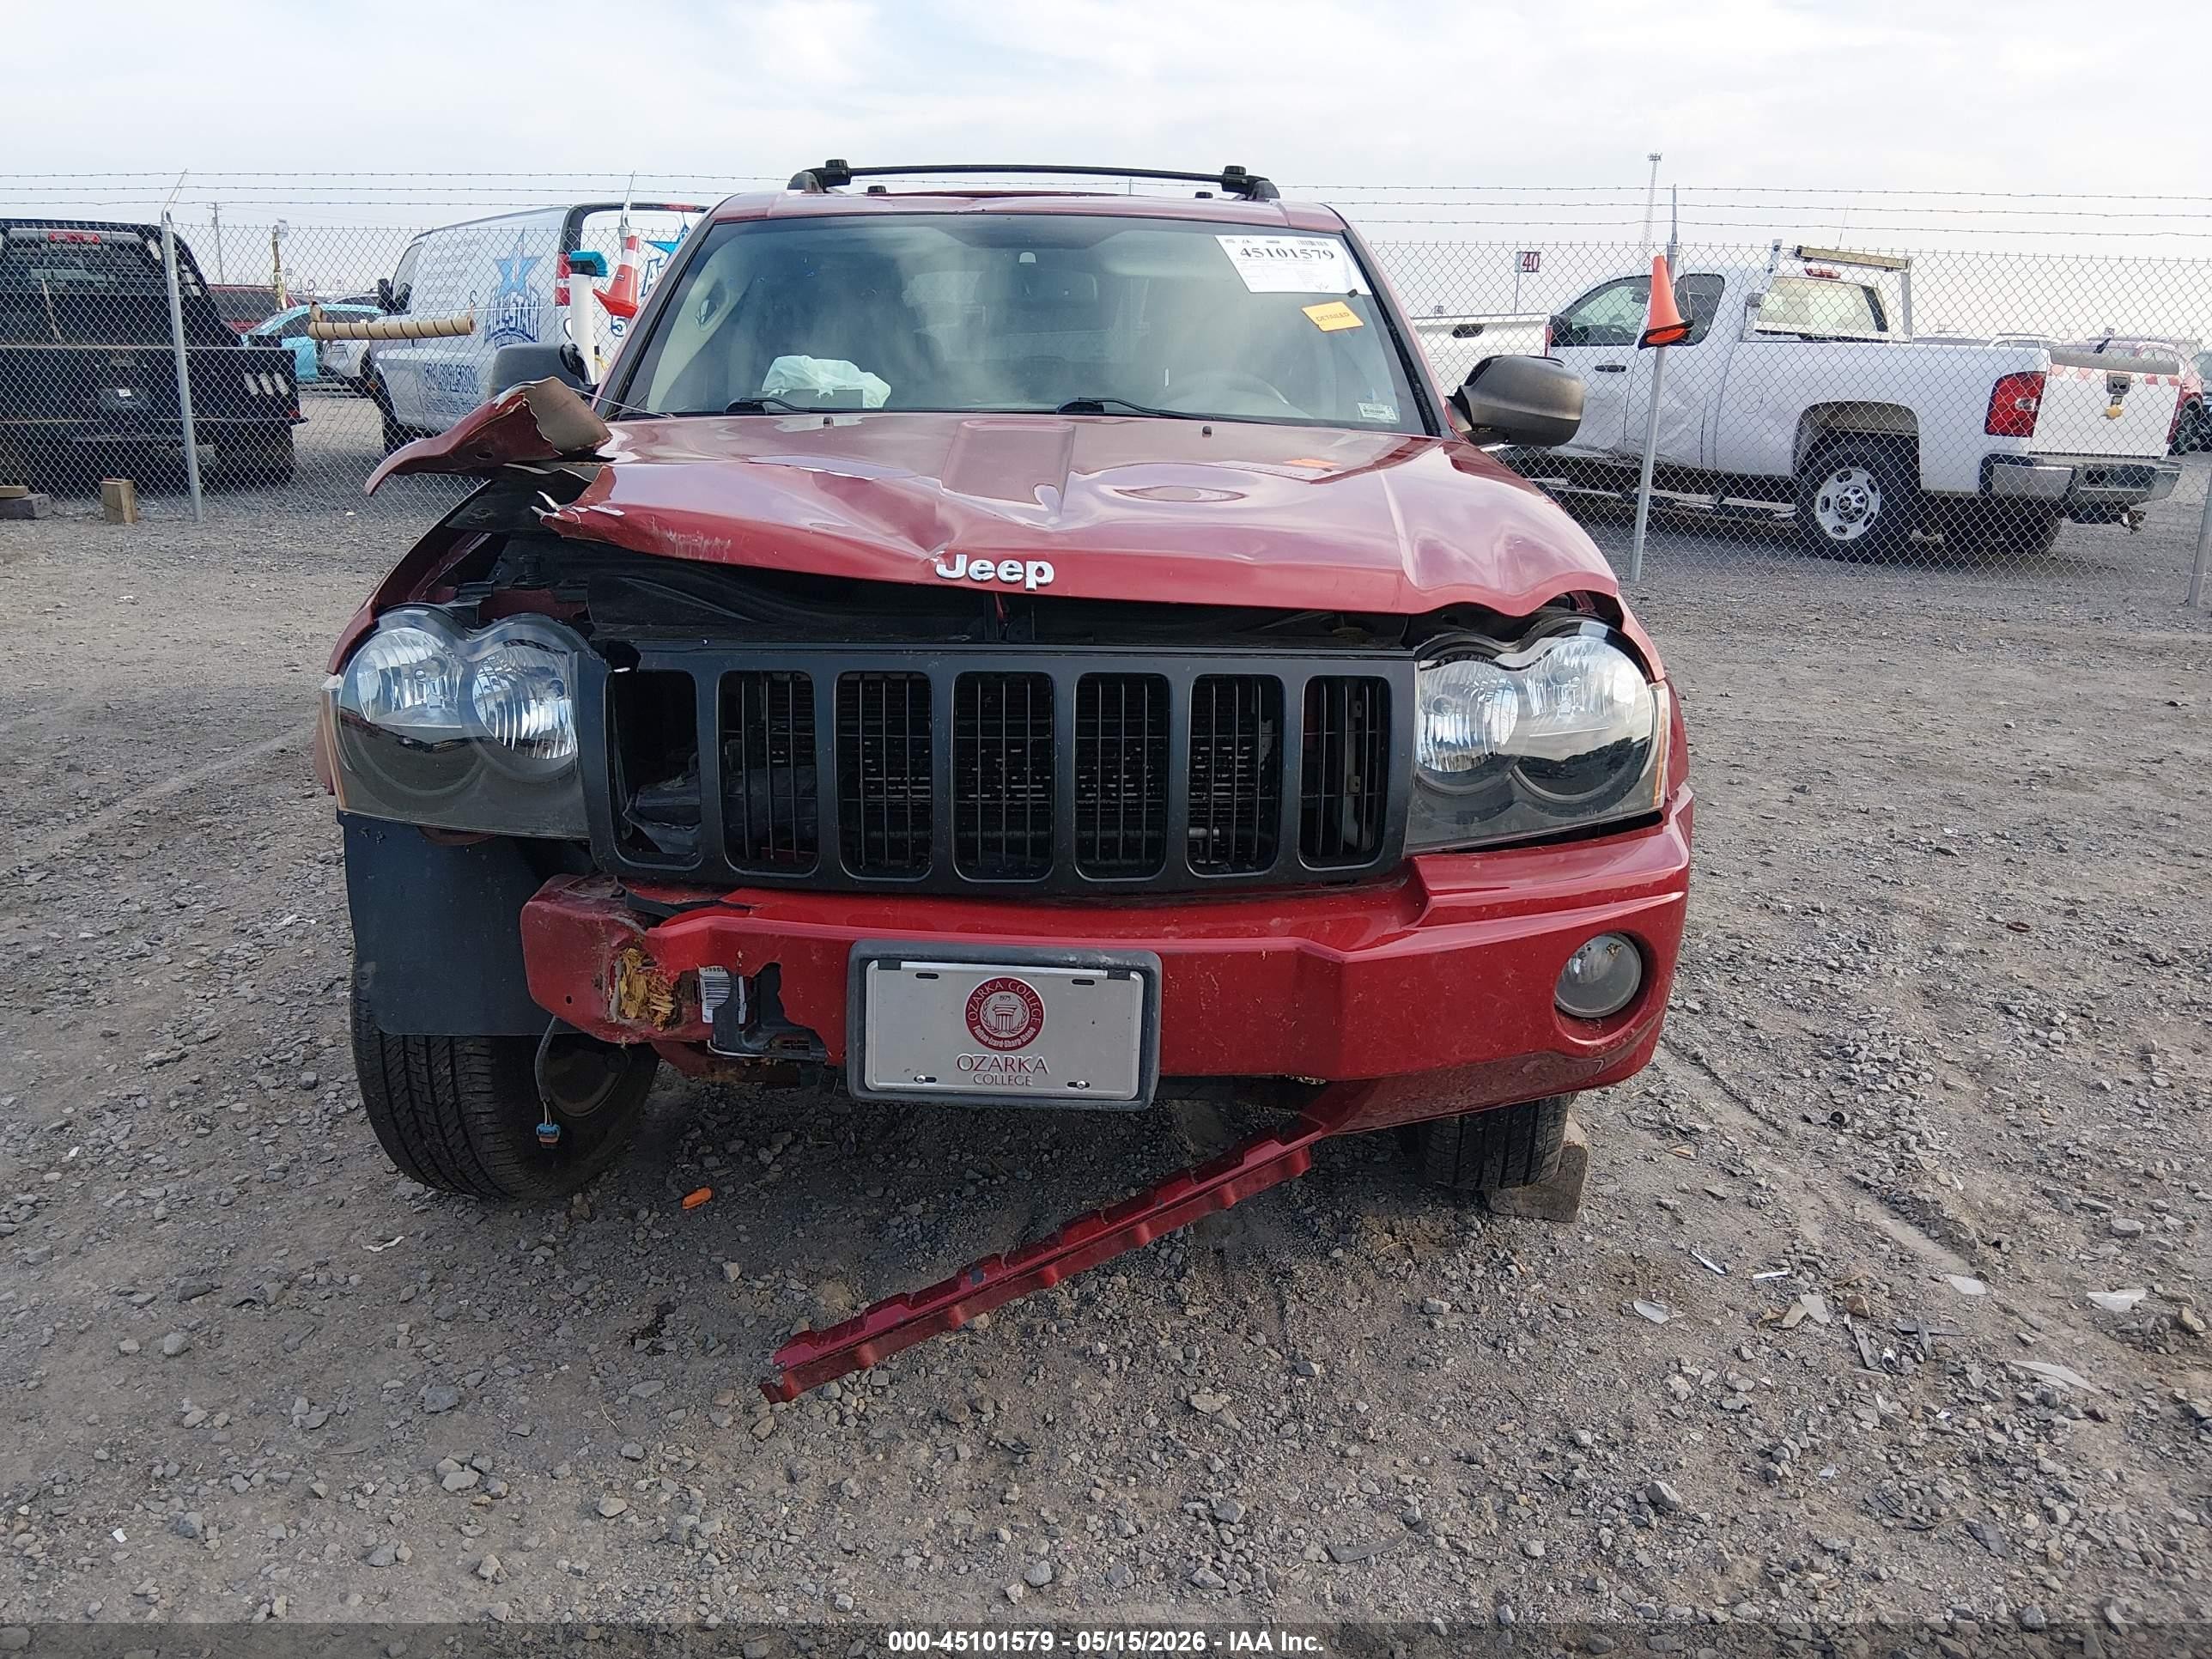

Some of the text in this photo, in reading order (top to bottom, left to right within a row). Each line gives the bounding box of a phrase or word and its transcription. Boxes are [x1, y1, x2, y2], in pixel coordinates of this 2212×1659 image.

[1240, 247, 1335, 260] 45101579
[1522, 252, 1540, 271] 40
[1316, 312, 1350, 322] DETAILED
[935, 554, 1055, 592] Jeep
[968, 981, 1042, 1024] OZARKA COLLEGE
[956, 1053, 1049, 1074] OZARKA
[973, 1073, 1033, 1086] COLLEGE
